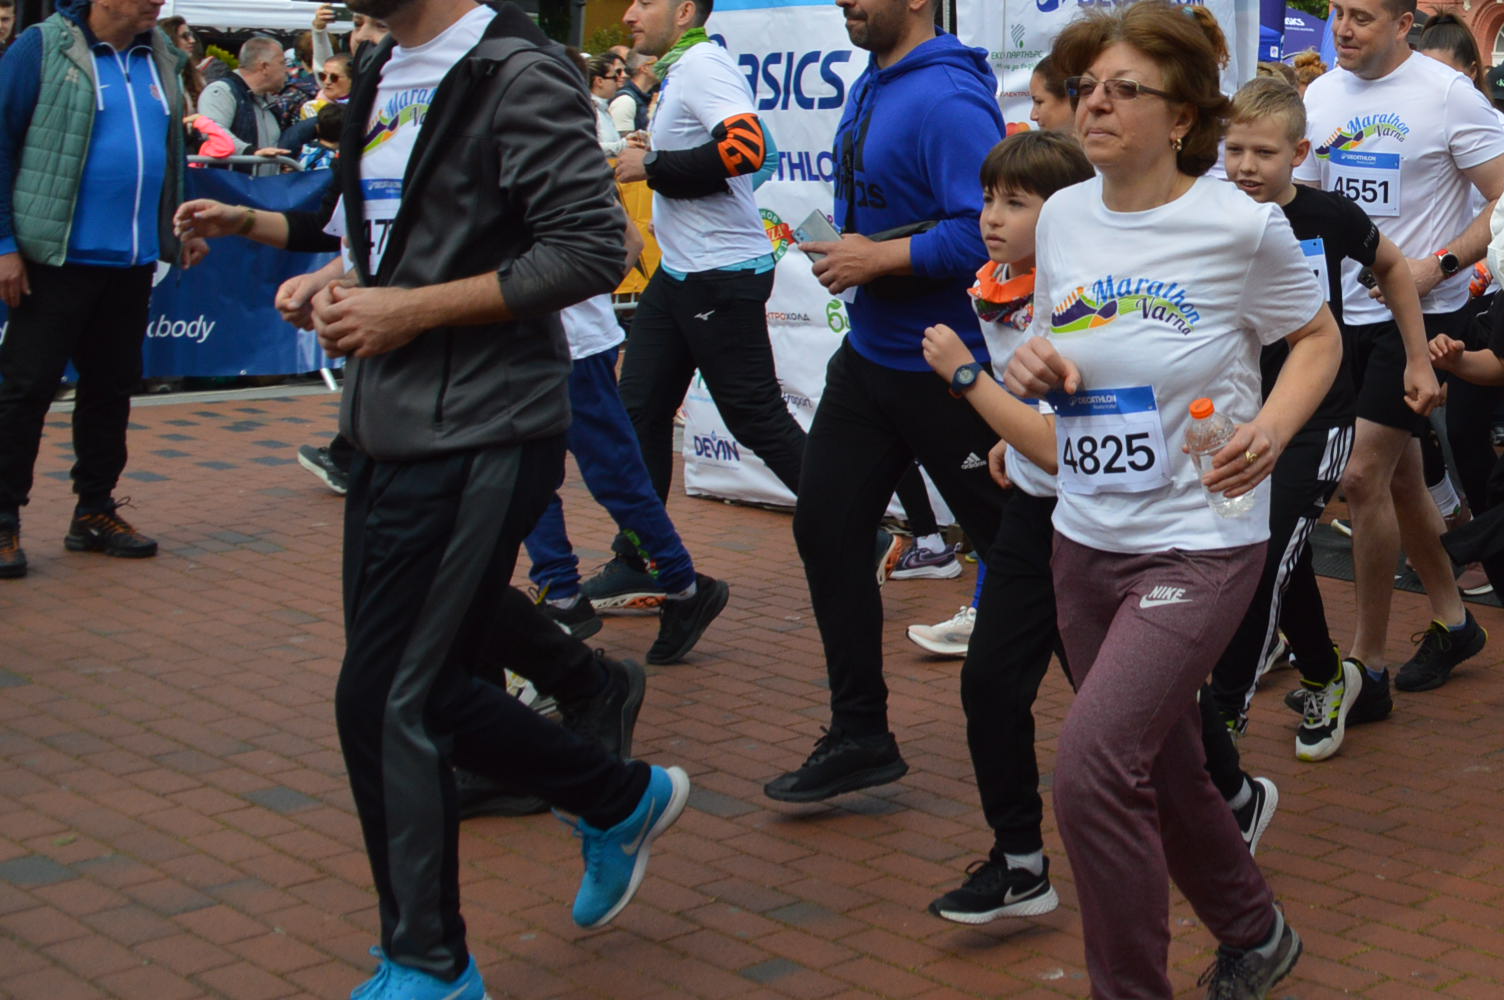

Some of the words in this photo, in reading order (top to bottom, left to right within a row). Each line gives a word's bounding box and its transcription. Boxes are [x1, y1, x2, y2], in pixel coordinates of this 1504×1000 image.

[1346, 112, 1410, 135] Marathon
[1374, 123, 1406, 143] Varna
[1333, 176, 1390, 204] 4551
[1092, 274, 1201, 326] Marathon
[1135, 296, 1192, 336] Varna
[694, 434, 741, 462] DEVIN
[1063, 431, 1156, 476] 4825
[1148, 585, 1186, 600] NIKE
